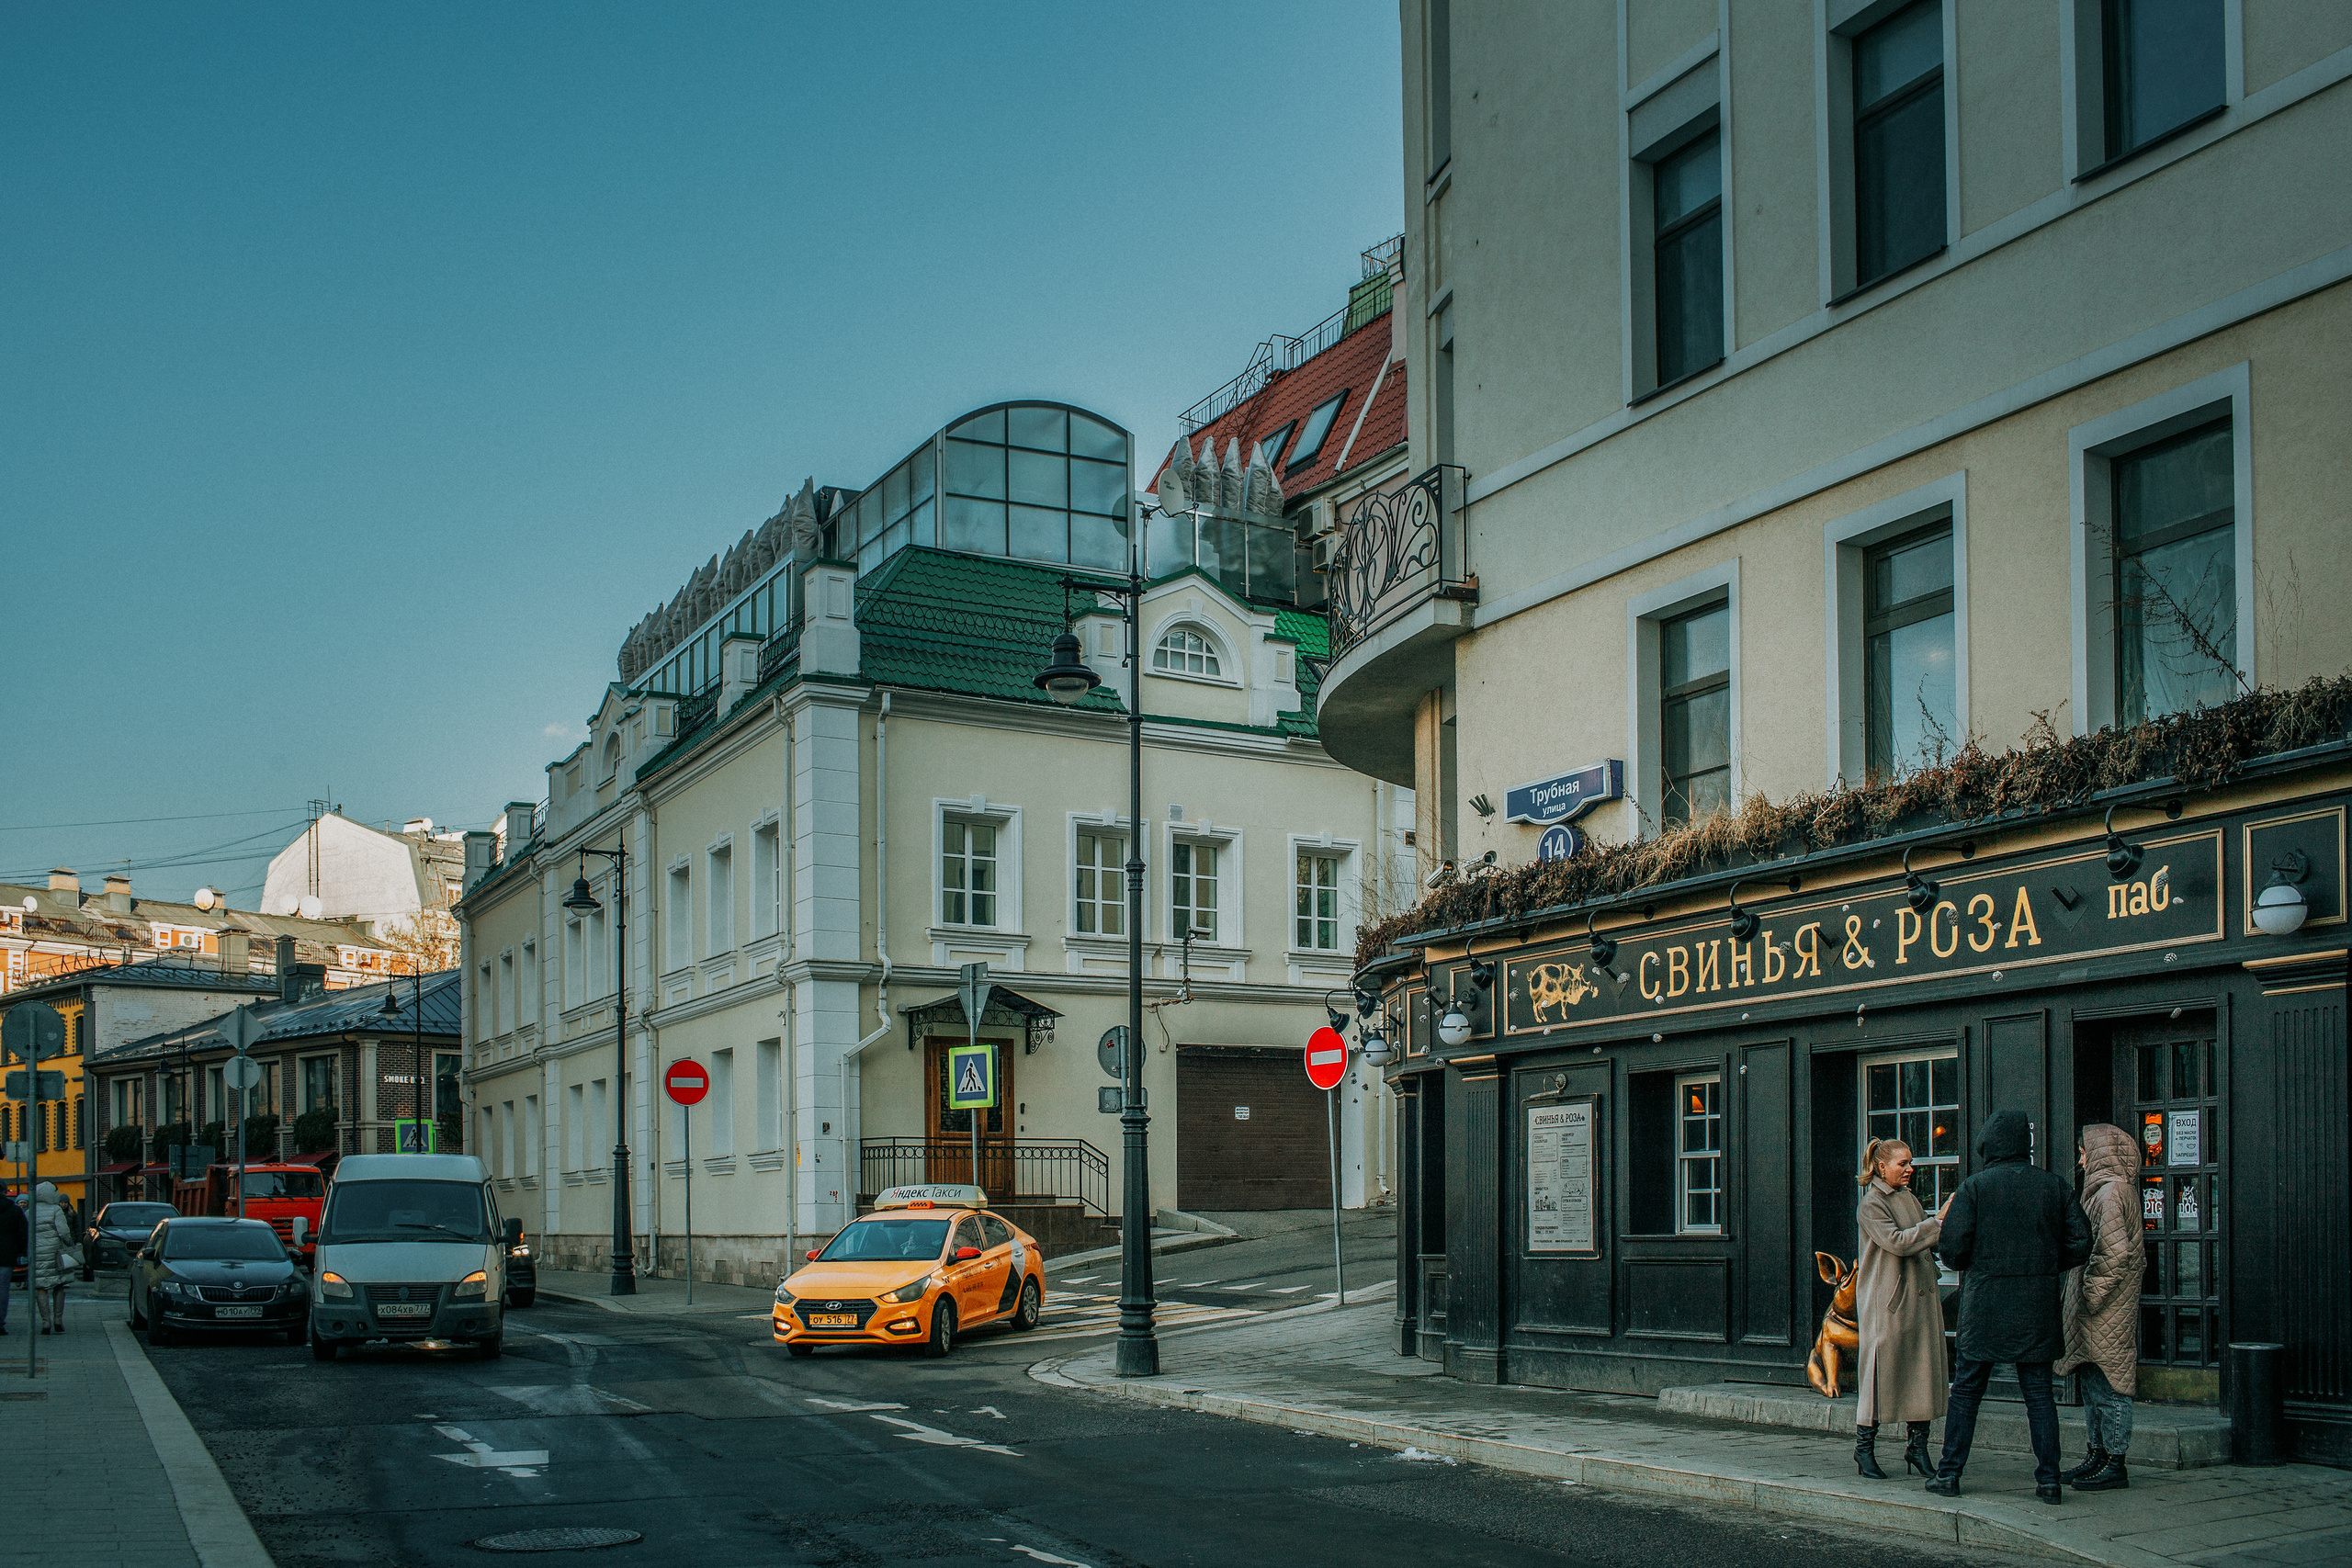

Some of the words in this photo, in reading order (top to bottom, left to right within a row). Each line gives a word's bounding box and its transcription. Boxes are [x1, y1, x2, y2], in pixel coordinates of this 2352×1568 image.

[1530, 781, 1579, 807] Трубная
[1542, 801, 1566, 818] улица
[1544, 834, 1566, 862] 14
[1639, 926, 1821, 999] СВИНЬЯ
[1842, 915, 1875, 969] &
[1894, 886, 2041, 964] РОЗА
[384, 1076, 409, 1084] SMOKE
[1535, 1114, 1559, 1125] СВИНЬЯ
[1565, 1112, 1581, 1122] РОЗА
[2177, 1118, 2197, 1128] ВХОД
[890, 1188, 930, 1199] Яндекс
[931, 1186, 962, 1198] Такси
[2144, 1201, 2163, 1213] PIG
[2178, 1202, 2198, 1213] DOG
[827, 1315, 842, 1324] 516
